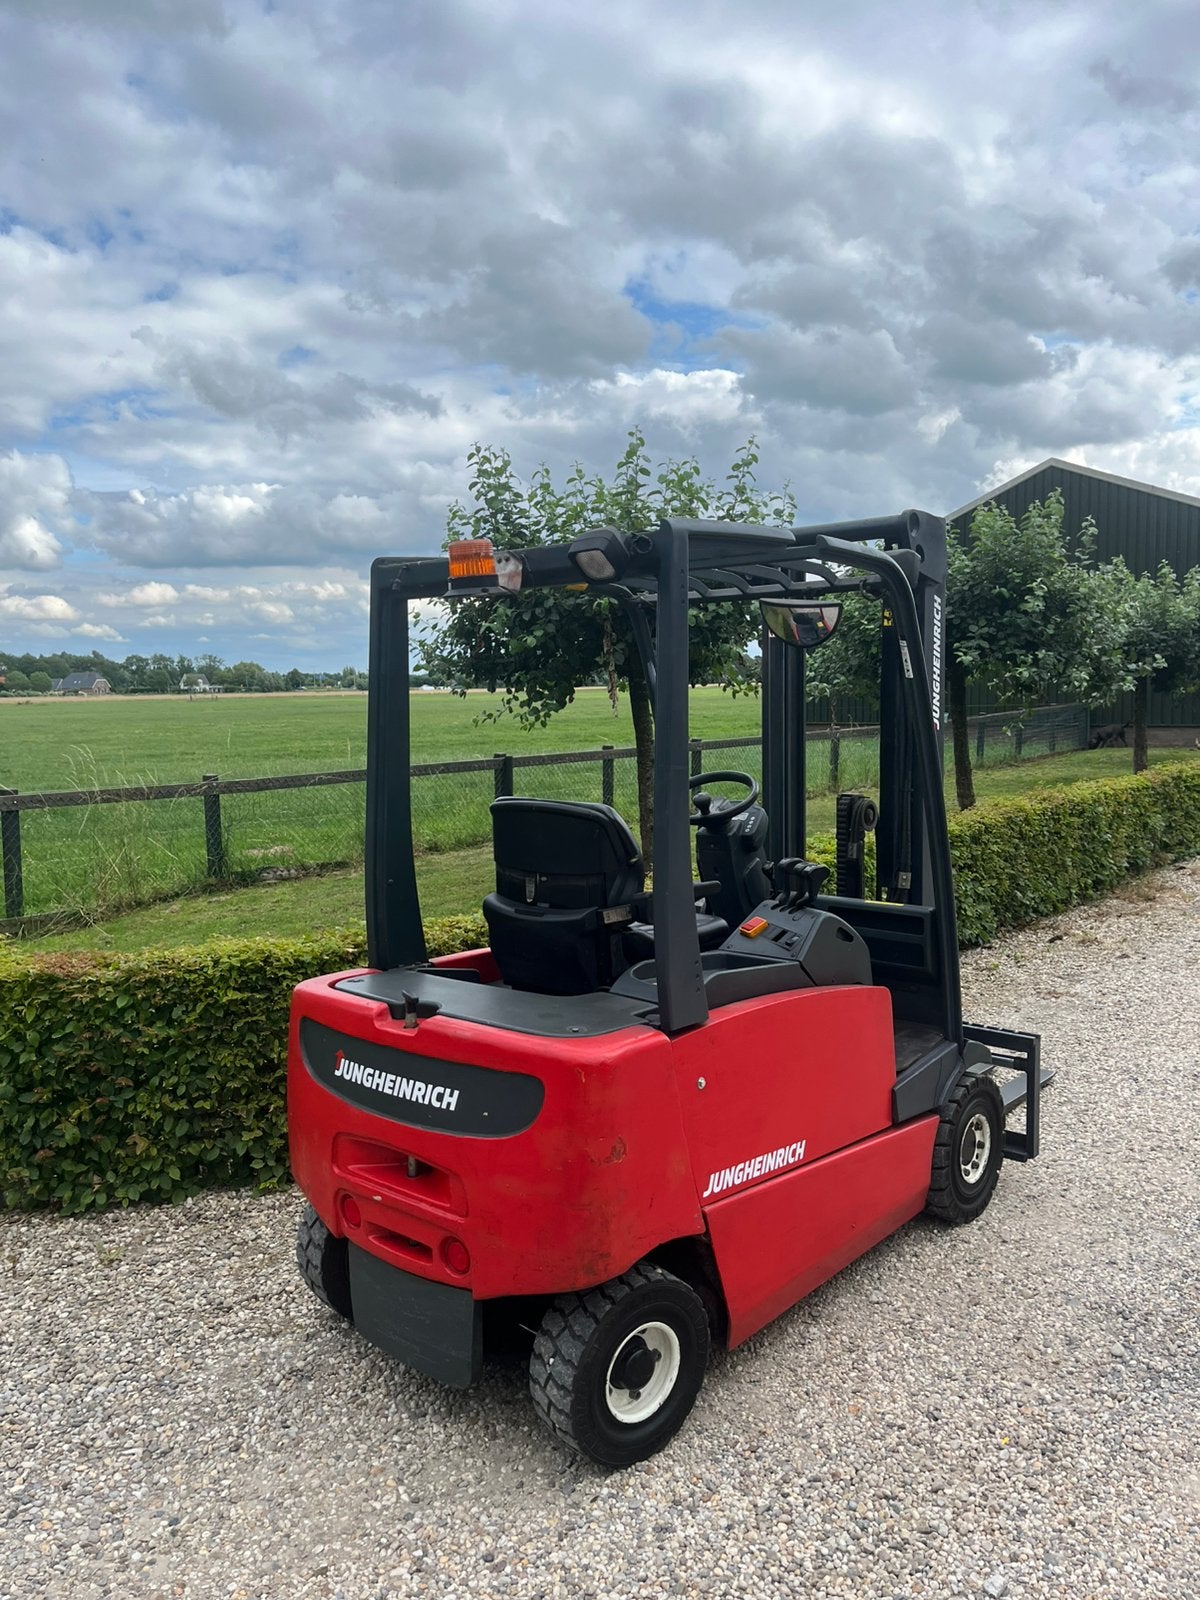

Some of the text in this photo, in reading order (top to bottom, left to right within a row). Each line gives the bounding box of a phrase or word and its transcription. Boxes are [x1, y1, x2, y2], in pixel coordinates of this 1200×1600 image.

[932, 594, 942, 730] JUNGHEINRICH
[334, 1058, 460, 1111] JUNGHEINRICH
[702, 1139, 806, 1198] JUNGHEINRICH
